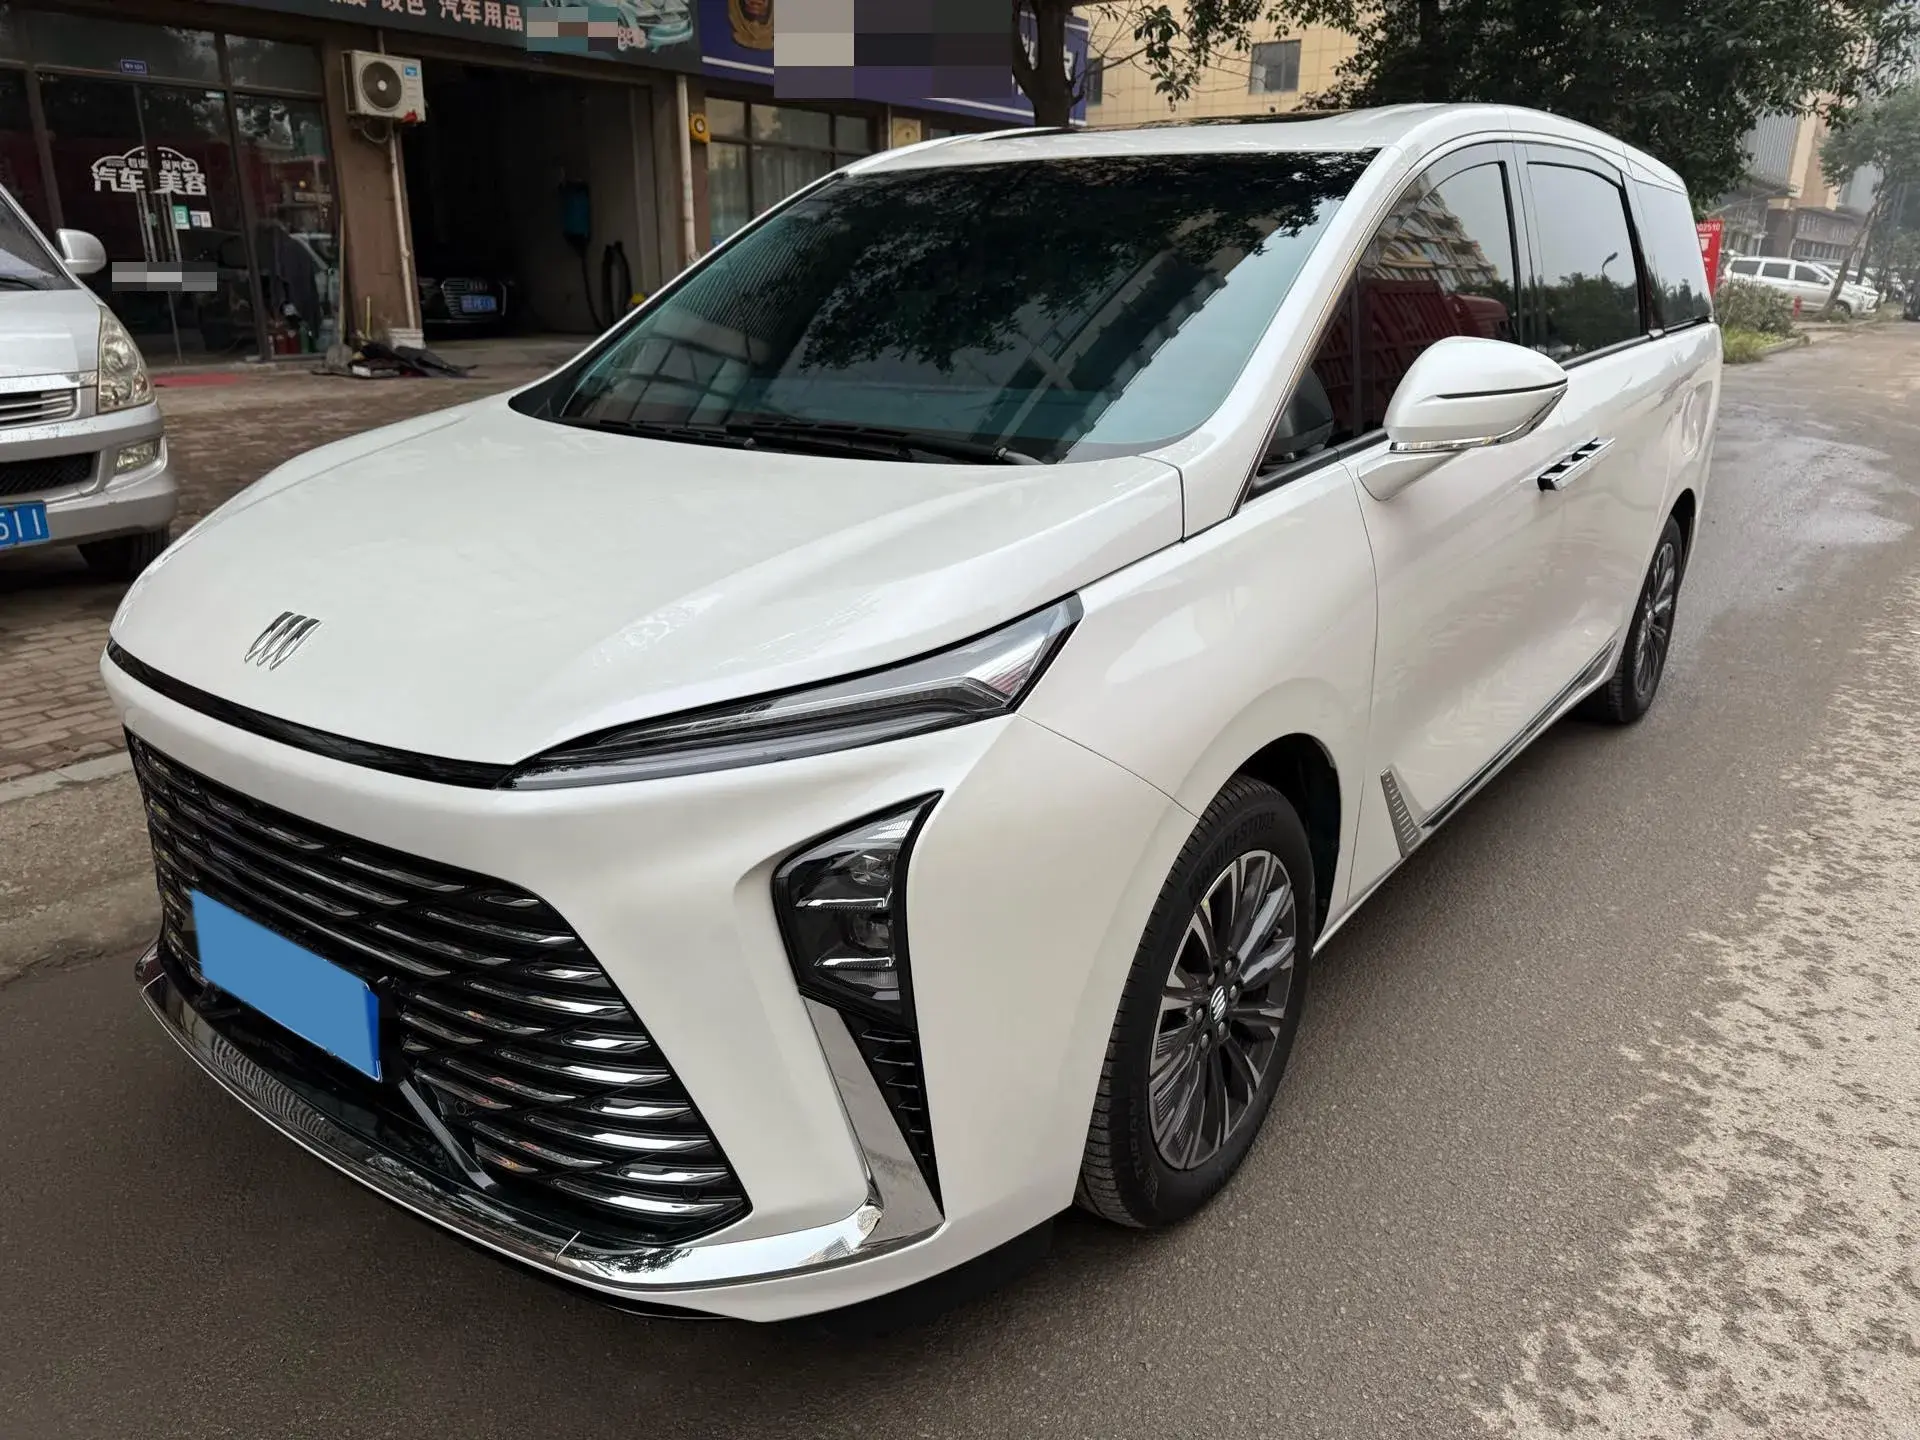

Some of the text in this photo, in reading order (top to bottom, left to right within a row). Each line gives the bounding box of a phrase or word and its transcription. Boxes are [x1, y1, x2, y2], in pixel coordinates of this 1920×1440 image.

[439, 0, 523, 31] 汽车用品
[92, 166, 206, 195] 汽车 美容
